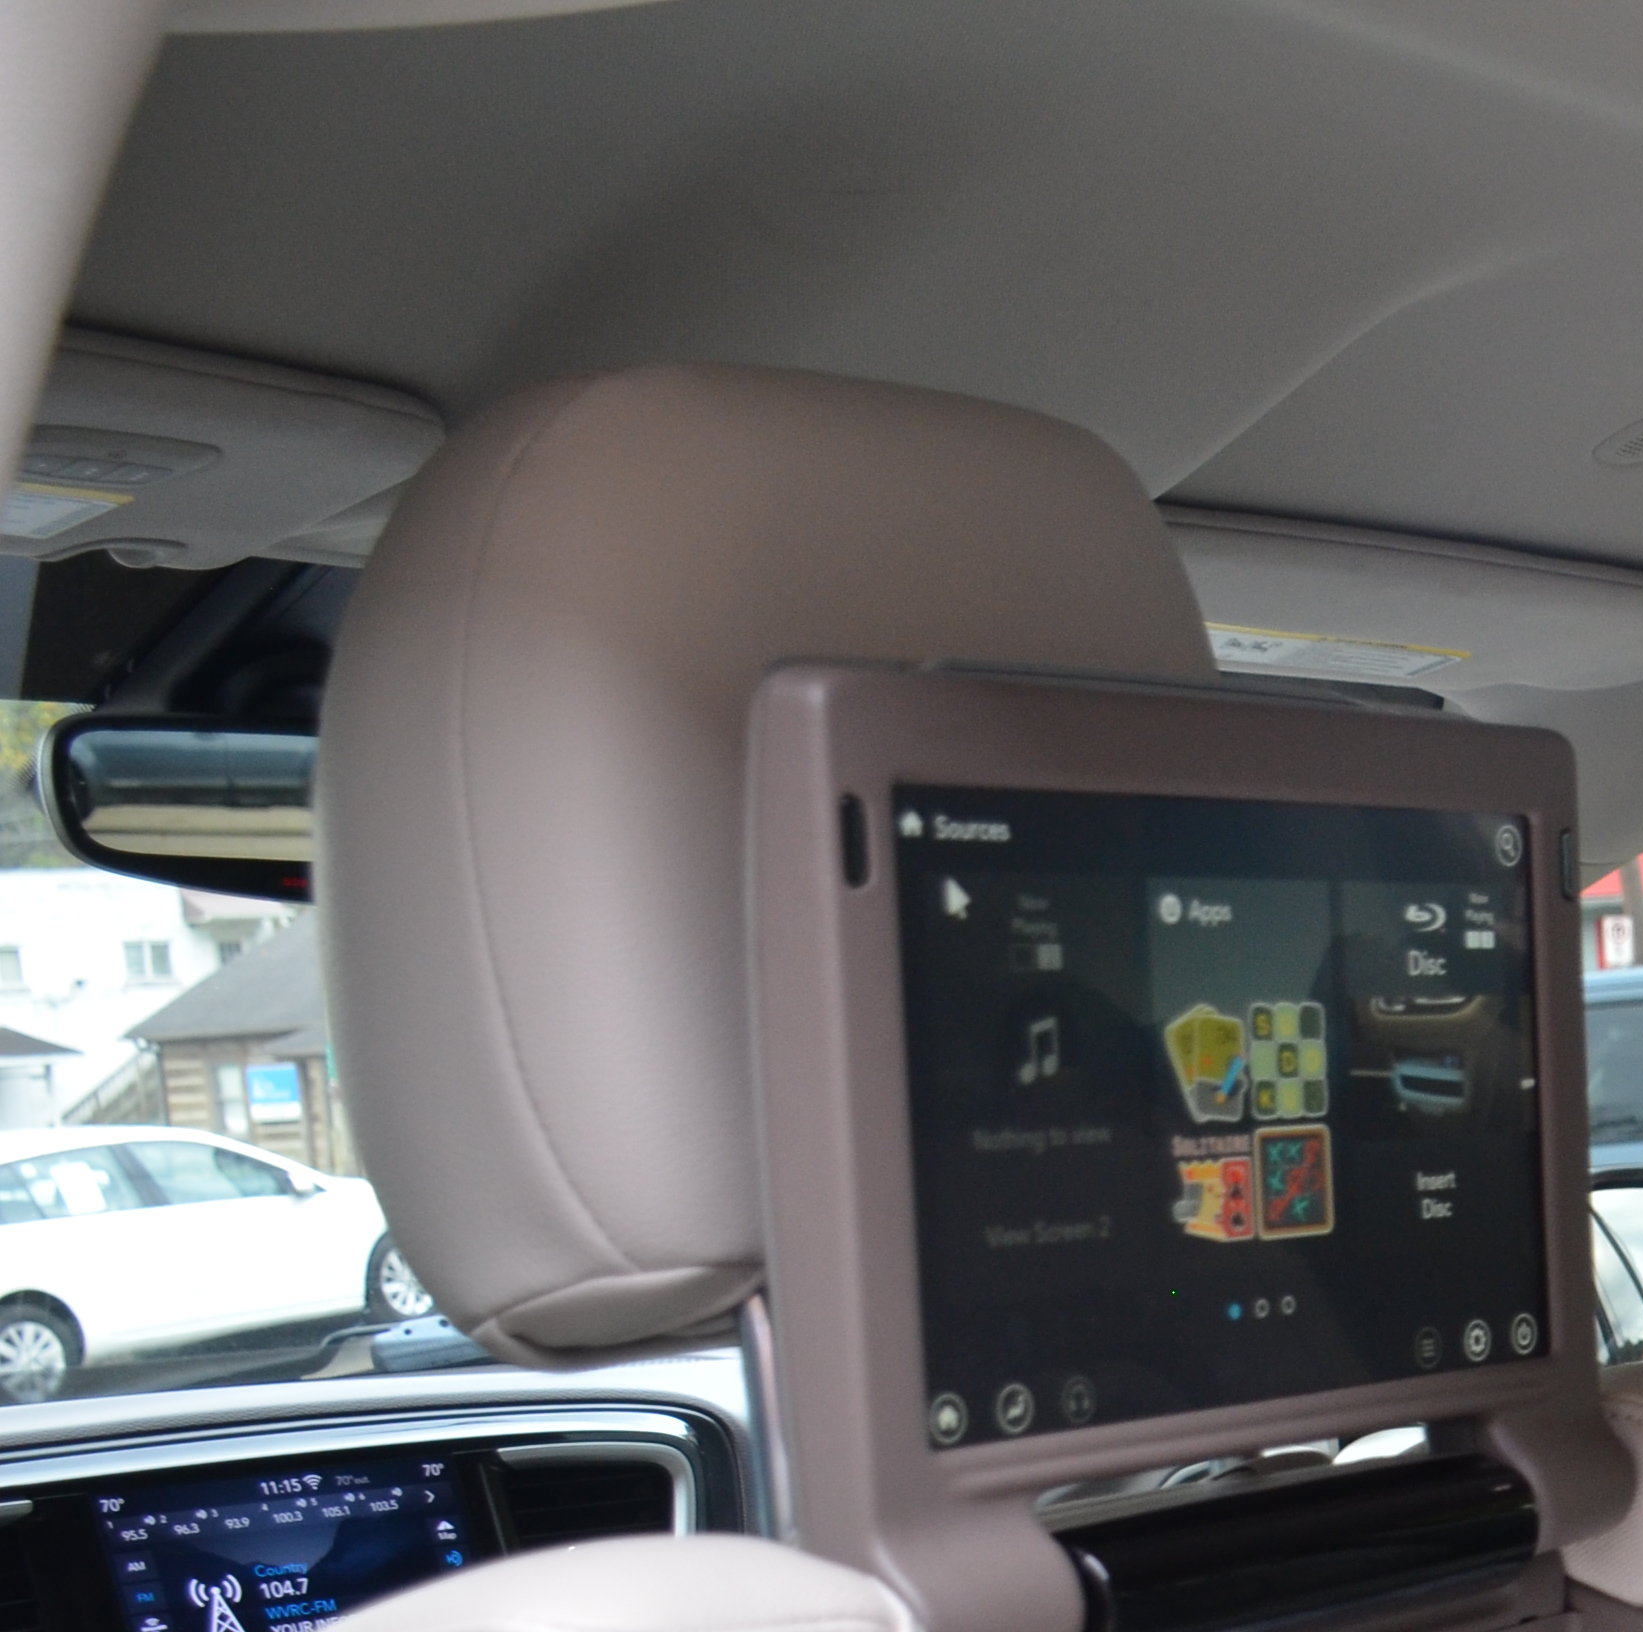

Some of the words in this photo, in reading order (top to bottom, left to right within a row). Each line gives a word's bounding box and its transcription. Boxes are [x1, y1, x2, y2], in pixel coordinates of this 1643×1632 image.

[933, 814, 1011, 842] Sources
[1188, 900, 1233, 926] Apps
[1407, 949, 1447, 976] Disc
[1416, 1171, 1457, 1191] Insert
[1421, 1198, 1453, 1219] Disc
[421, 1462, 445, 1477] 70°
[260, 1478, 303, 1496] 11:15
[99, 1497, 125, 1513] 70°
[321, 1505, 351, 1518] 105.1
[369, 1499, 400, 1513] 103.5
[224, 1517, 250, 1529] 93.9
[273, 1510, 304, 1524] 100.3
[121, 1528, 149, 1541] 95.5
[173, 1522, 201, 1536] 96.3
[127, 1560, 147, 1572] AM
[254, 1562, 309, 1579] Country
[259, 1577, 310, 1600] 104.7
[136, 1592, 155, 1603] FM
[264, 1599, 338, 1621] WVRC-FM
